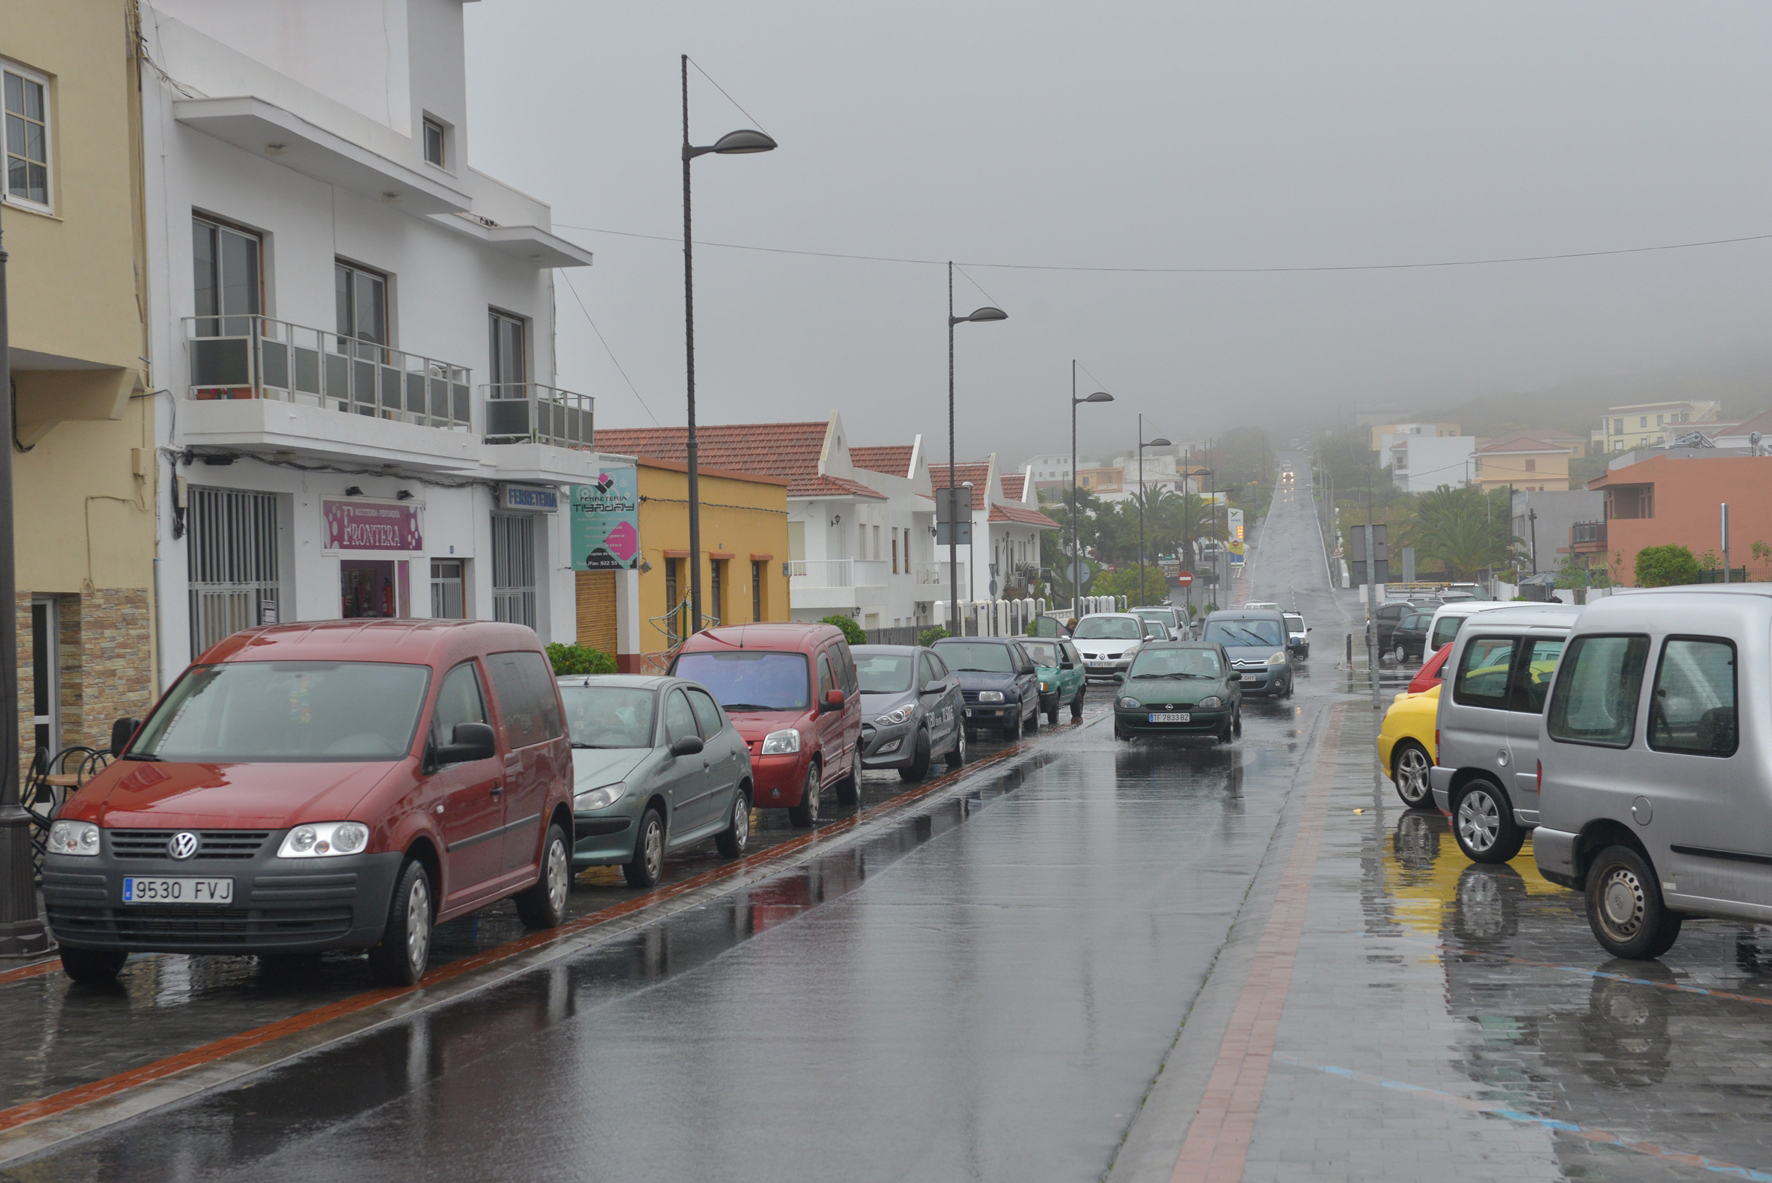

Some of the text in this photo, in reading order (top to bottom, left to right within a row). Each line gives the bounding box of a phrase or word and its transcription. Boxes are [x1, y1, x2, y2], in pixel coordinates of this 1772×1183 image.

[509, 488, 557, 508] FERRETERIA
[342, 506, 401, 546] FRONTERA
[136, 881, 231, 900] 9530 FVJ
